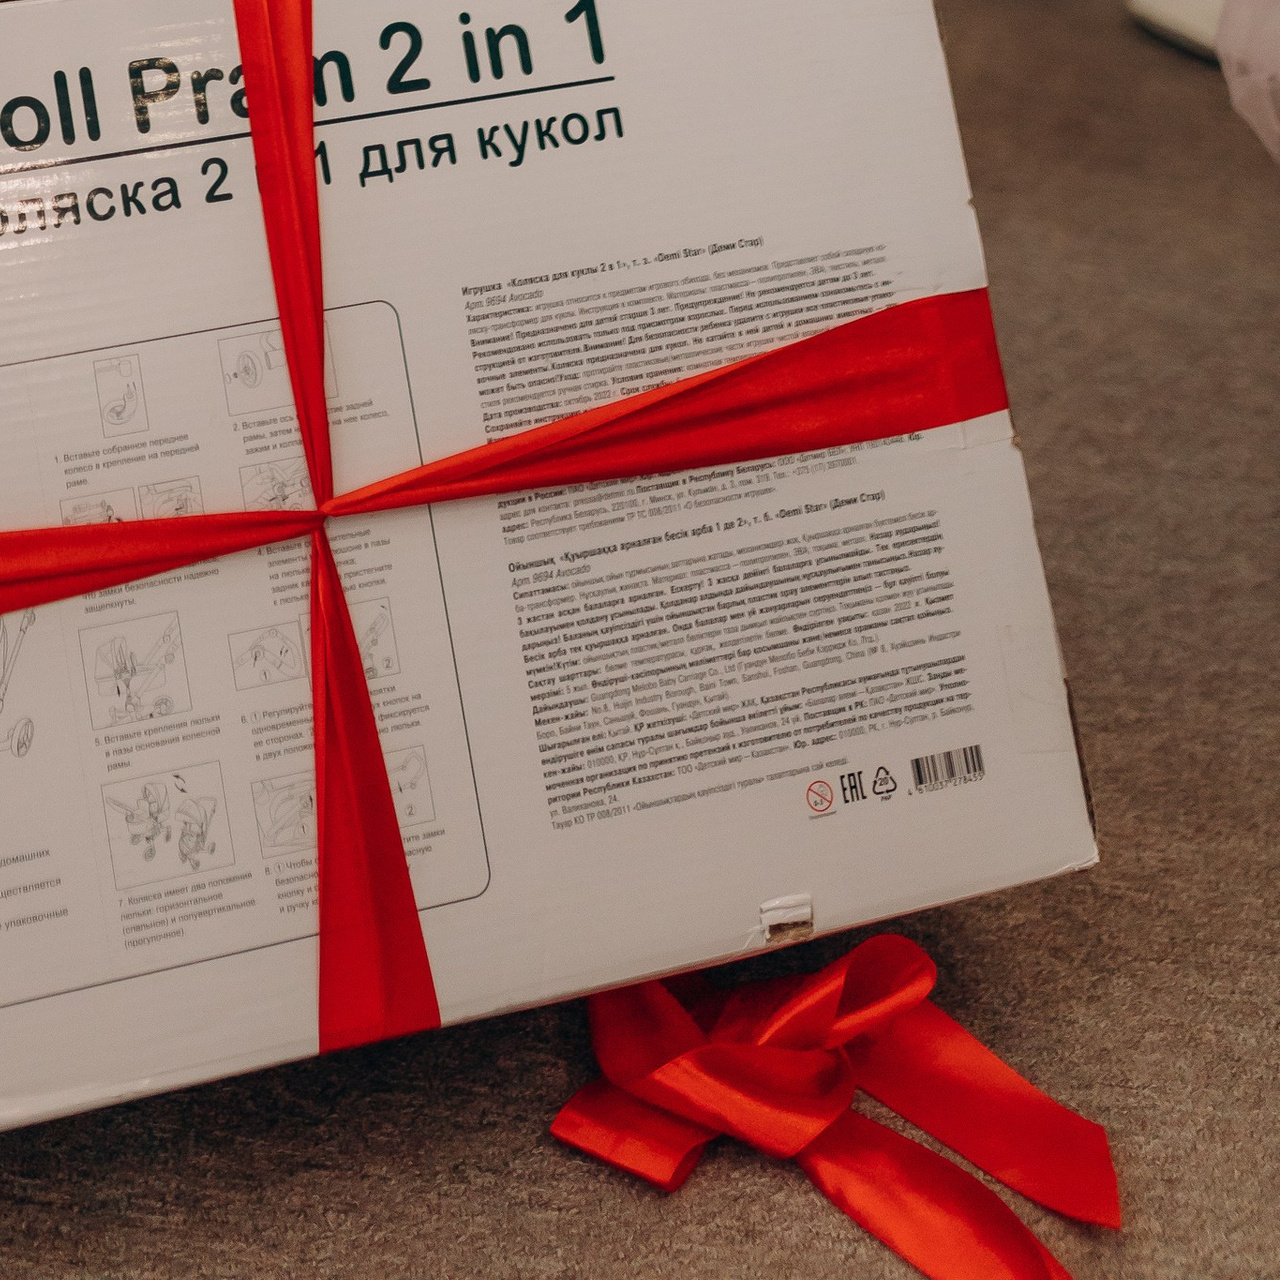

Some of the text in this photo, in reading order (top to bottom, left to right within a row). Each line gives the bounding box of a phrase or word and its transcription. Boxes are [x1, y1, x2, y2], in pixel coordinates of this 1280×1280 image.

[378, 21, 430, 94] 2
[458, 11, 533, 84] in
[201, 157, 232, 204] 2
[312, 141, 332, 184] 1
[359, 132, 456, 186] для
[477, 106, 623, 167] кукол
[63, 442, 200, 475] колесо в крепление на передней
[104, 725, 221, 758] в пазы основания колесной
[839, 770, 867, 804] EAC
[0, 848, 50, 868] домашних
[3, 907, 69, 932] упаковочные
